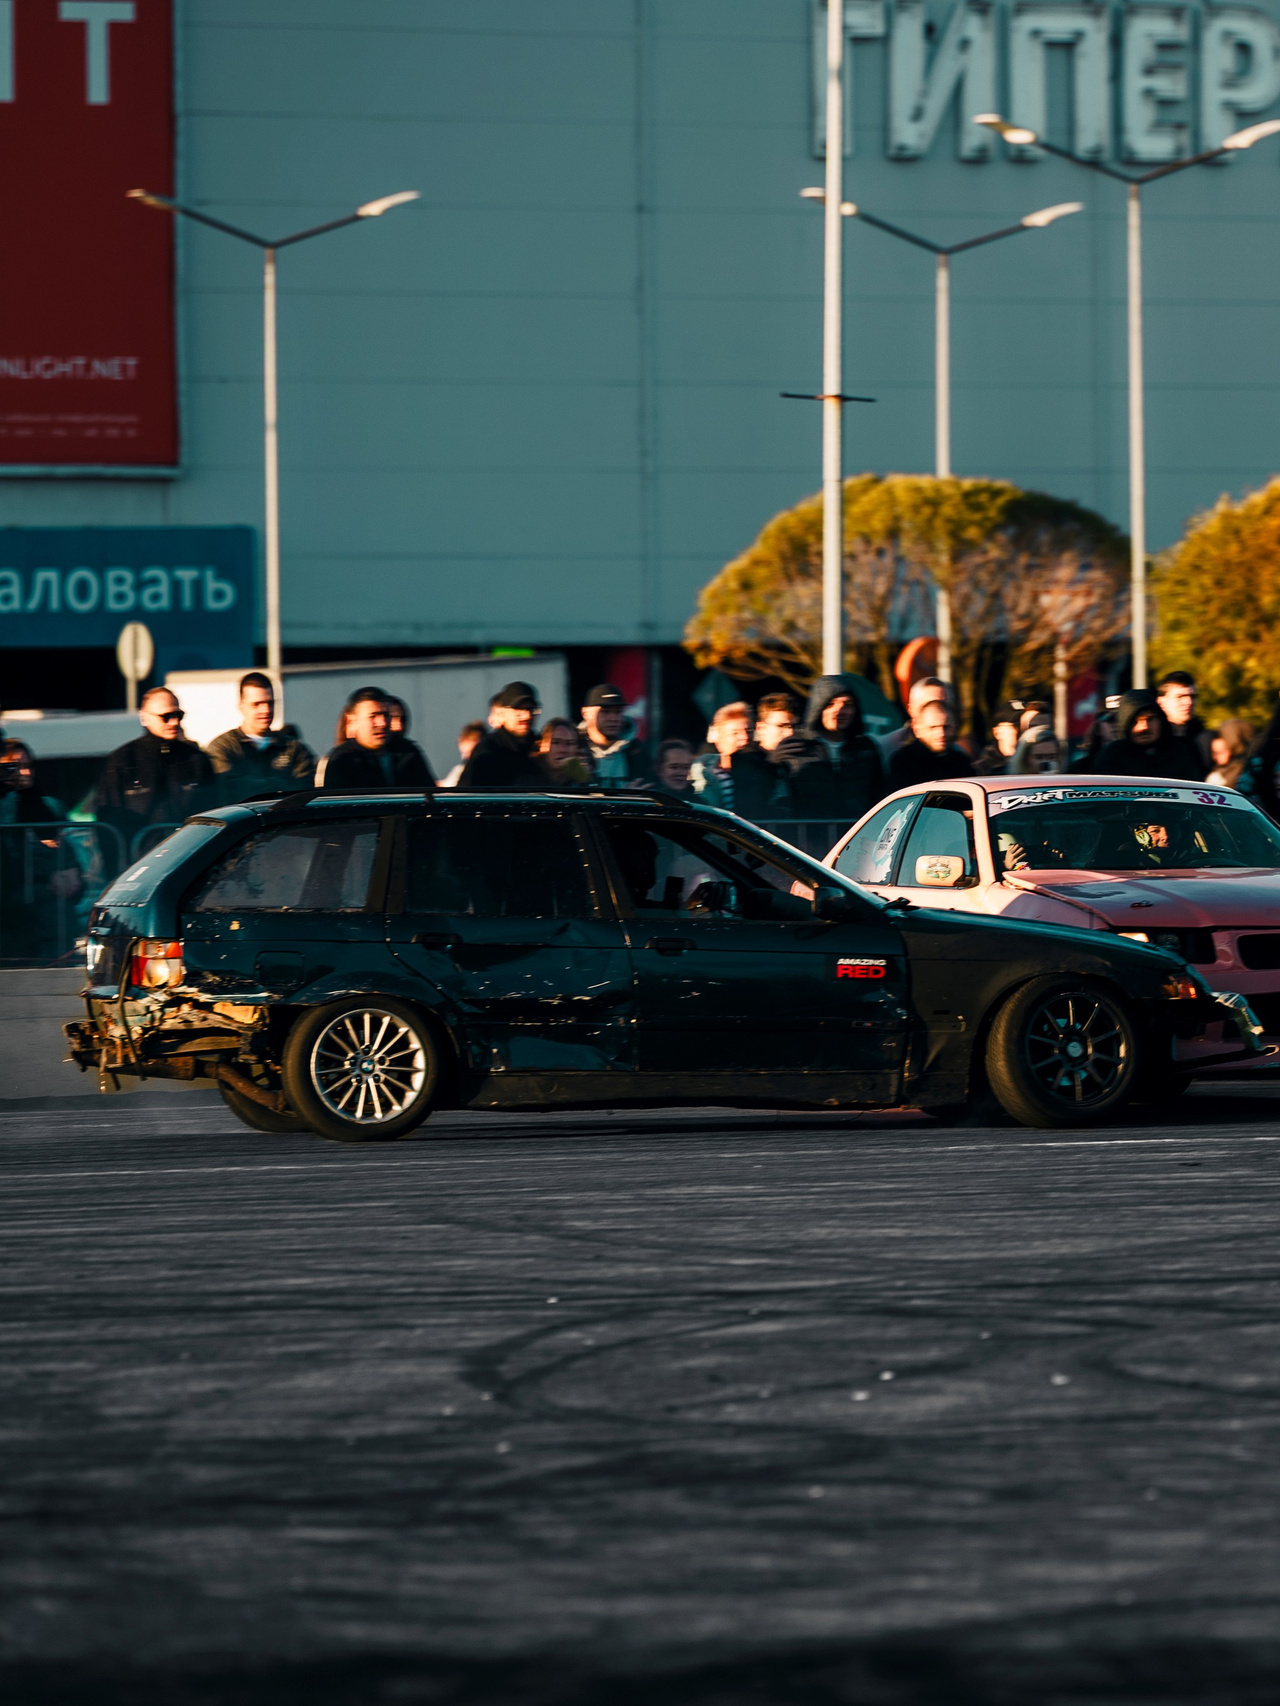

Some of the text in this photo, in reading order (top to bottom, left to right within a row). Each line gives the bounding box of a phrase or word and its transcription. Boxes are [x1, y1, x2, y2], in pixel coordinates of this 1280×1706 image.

[0, 567, 237, 613] аловать
[1192, 790, 1232, 807] 32
[836, 965, 886, 979] RED
